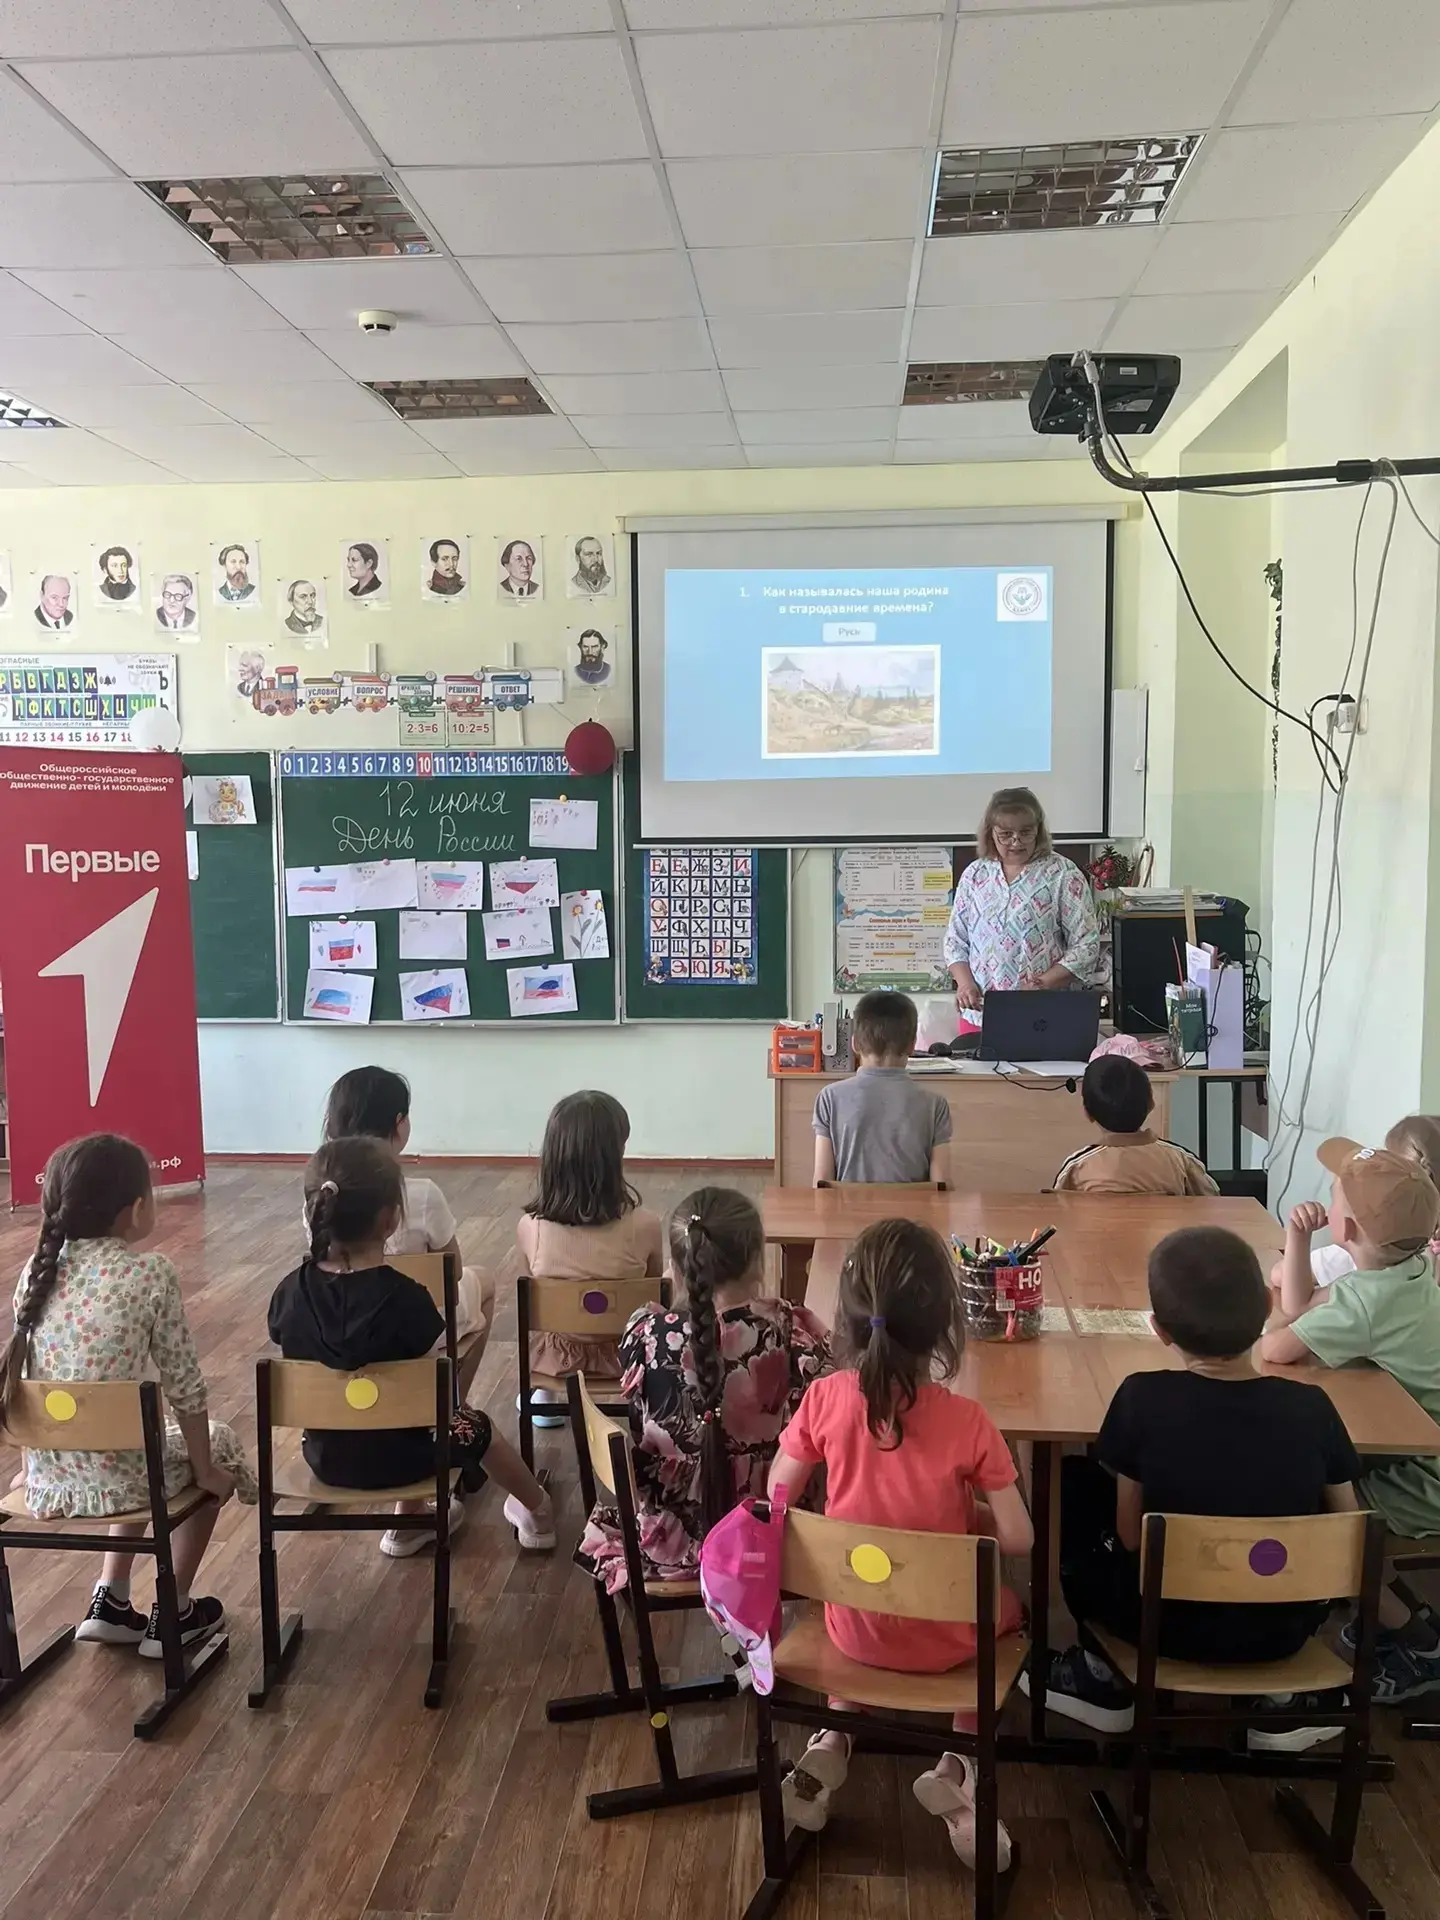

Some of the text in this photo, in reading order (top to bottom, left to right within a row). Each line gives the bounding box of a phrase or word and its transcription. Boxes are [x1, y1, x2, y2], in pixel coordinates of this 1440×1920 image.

[763, 586, 786, 597] Как
[789, 587, 864, 597] называлась
[867, 587, 901, 597] наша
[903, 586, 949, 598] родина
[789, 603, 869, 615] стародавние
[873, 601, 934, 615] времена?
[13, 673, 21, 689] Б
[27, 673, 36, 689] В
[42, 673, 49, 689] Г
[57, 672, 66, 690] Д
[72, 672, 80, 689] З
[84, 672, 96, 689] Ж
[308, 688, 338, 696] УСЛОВИЕ
[356, 686, 384, 695] ВОПРОС
[448, 686, 479, 694] РЕШЕНИЕ
[28, 700, 39, 716] Ф
[44, 700, 52, 716] К
[59, 699, 66, 716] Т
[73, 699, 81, 716] С
[102, 700, 109, 715] Х
[453, 723, 489, 733] 10:2=5
[15, 732, 28, 742] 12
[33, 732, 46, 742] 13
[50, 732, 64, 742] 14
[68, 732, 82, 742] 15
[86, 732, 100, 742] 16
[104, 732, 117, 742] 17
[39, 763, 137, 775] Общероссийское
[283, 756, 568, 773] 0 1 2 3 4 5 6 7 8 9 10 11 12 13 14 15 16 17 18 19
[0, 771, 175, 786] общественно- государственное
[10, 782, 67, 790] движение
[68, 782, 101, 792] детей
[111, 784, 167, 793] молодёжи
[379, 780, 512, 818] 12 июня
[332, 814, 516, 854] День России
[25, 843, 161, 883] Первые
[652, 858, 749, 872] Е Ё Ж З И
[652, 879, 749, 893] Й К Л М Н
[651, 899, 747, 913] О П Р С Т
[653, 920, 747, 935] У Ф Х Ц Ч
[652, 940, 744, 955] Ш Щ Ъ Ы Ь
[672, 960, 724, 974] Э Ю Я
